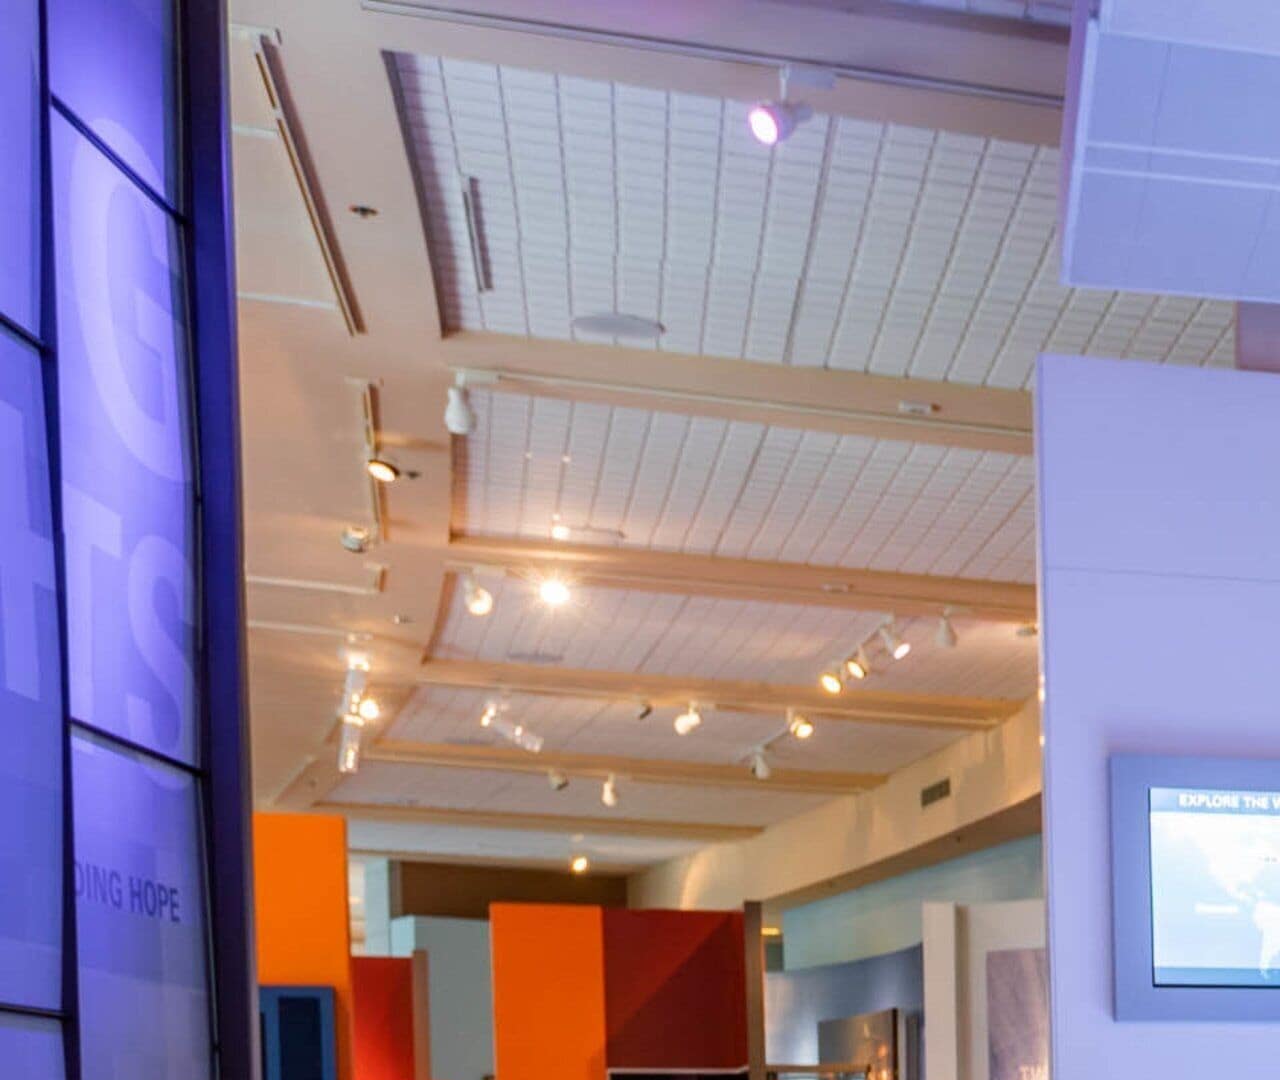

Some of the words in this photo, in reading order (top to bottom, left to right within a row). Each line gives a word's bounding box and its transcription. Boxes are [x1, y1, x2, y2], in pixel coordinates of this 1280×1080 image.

[1178, 792, 1240, 809] EXPLORE
[1243, 795, 1268, 810] THE
[128, 874, 180, 923] HOPE
